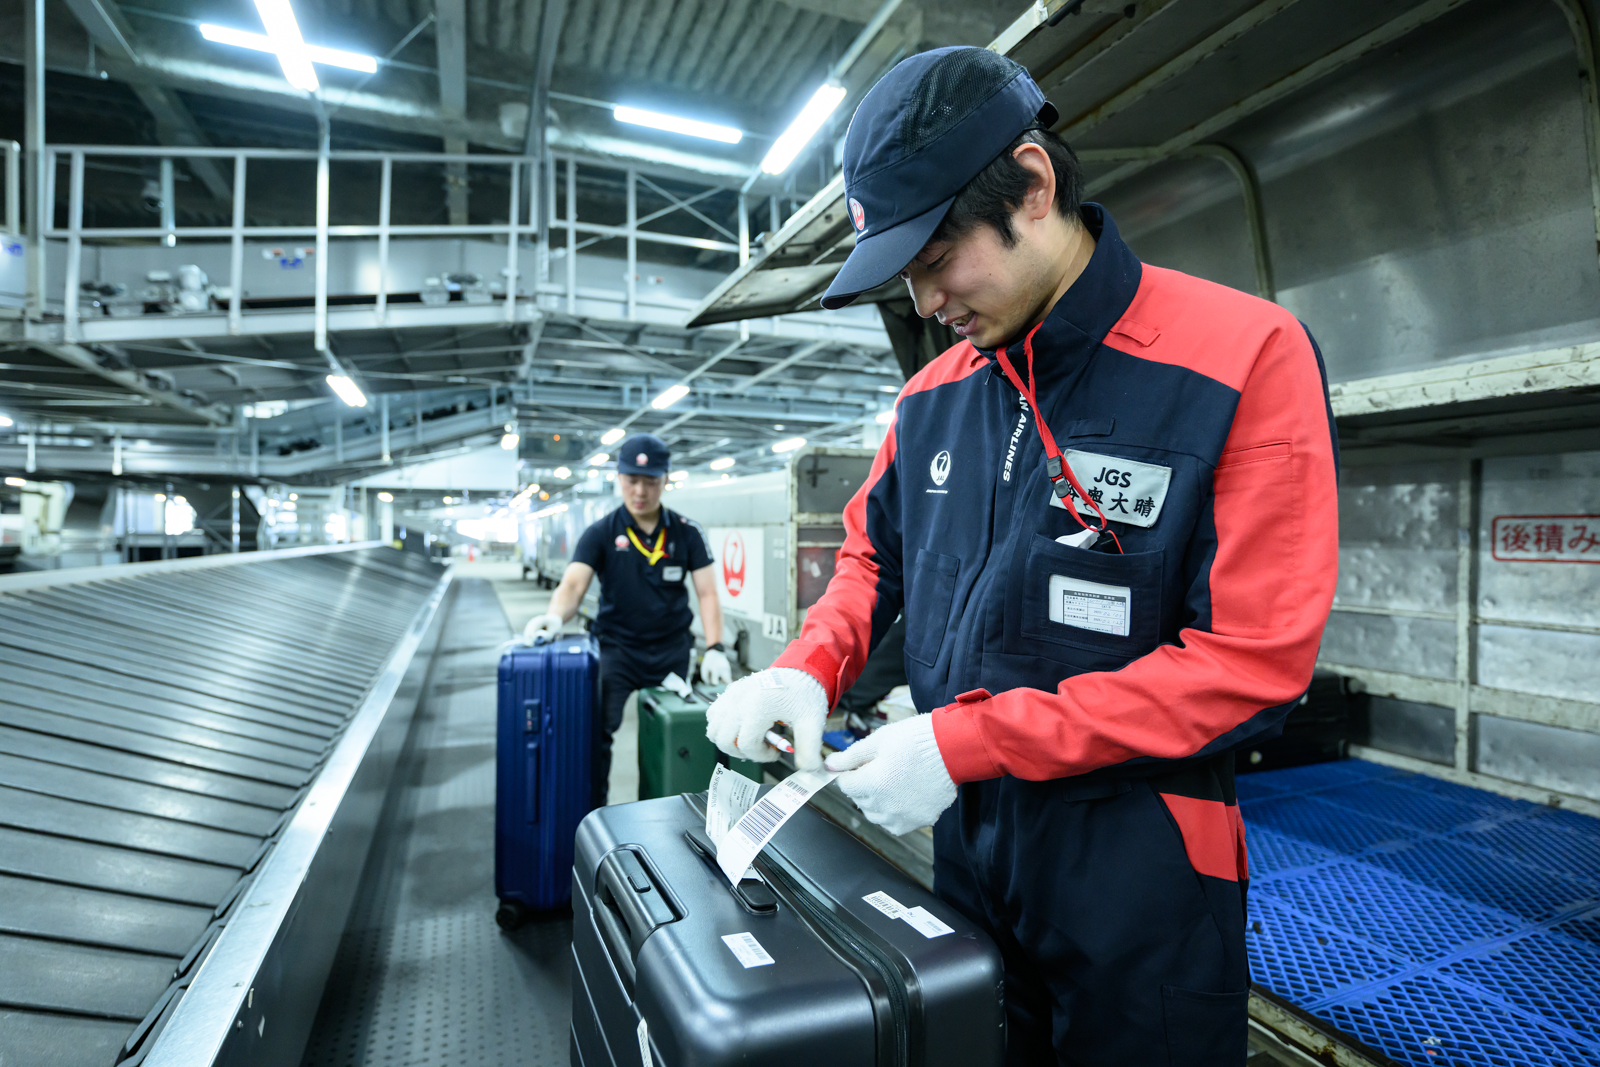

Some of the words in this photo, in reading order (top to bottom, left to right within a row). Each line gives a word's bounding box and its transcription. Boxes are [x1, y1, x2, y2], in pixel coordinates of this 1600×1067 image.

[1003, 413, 1027, 482] AIRLINES
[1094, 467, 1132, 488] JGS
[1502, 523, 1600, 554] 後積み
[768, 618, 784, 637] JA
